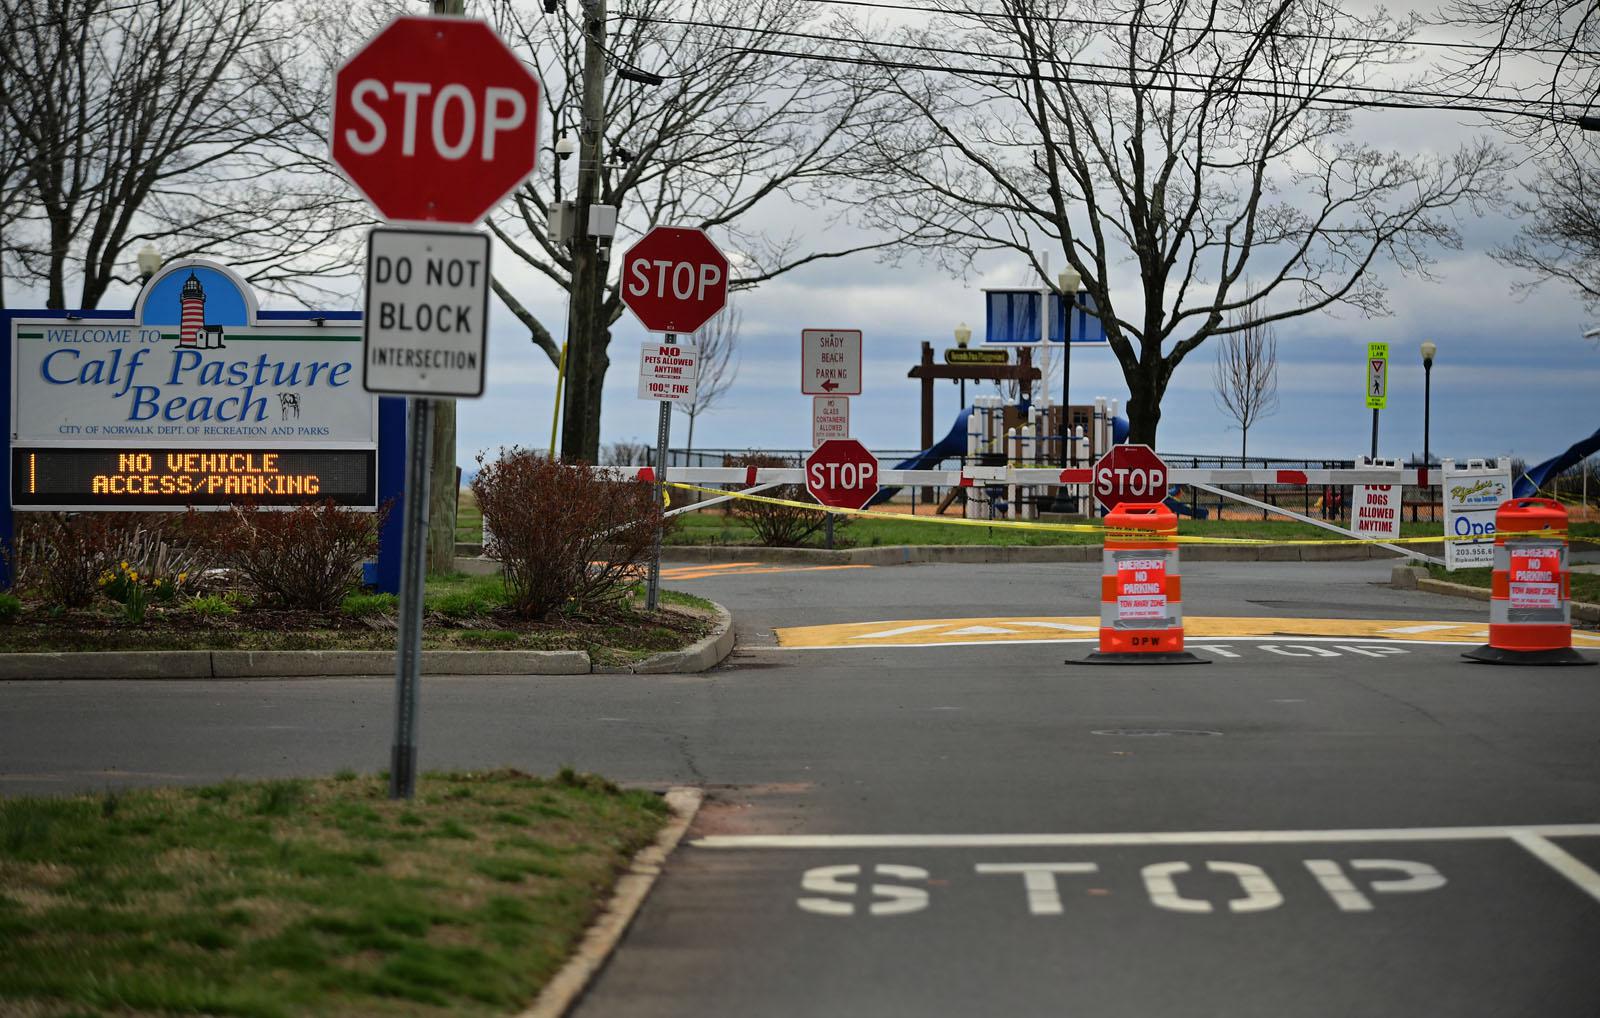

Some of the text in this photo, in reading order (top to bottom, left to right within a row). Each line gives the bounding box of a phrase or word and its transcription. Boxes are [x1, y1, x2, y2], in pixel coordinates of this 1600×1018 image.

[345, 78, 527, 161] STOP
[376, 255, 480, 288] DO NOT
[629, 257, 721, 301] STOP
[380, 302, 471, 333] BLOCK
[48, 330, 161, 343] WELCOME TO
[820, 337, 844, 348] SHADY
[659, 346, 681, 357] NO
[821, 352, 844, 363] BEACH
[372, 347, 477, 371] INTERSECTION
[644, 356, 694, 367] PETS ALLOWED
[42, 348, 352, 399] Calf Pasture
[654, 365, 682, 375] ANYTIME
[815, 368, 847, 379] PARKING
[672, 384, 689, 394] FINE
[128, 385, 269, 423] Beach
[59, 425, 330, 435] CITY OF NORWALK DEPT. OF RECREATION AND PARKS
[119, 453, 279, 472] NO VEHICLE
[810, 462, 874, 490] STOP
[1097, 468, 1164, 497] STOP
[92, 475, 320, 494] ACCESS/PARKING
[1366, 493, 1389, 505] DOGS
[1359, 506, 1394, 519] ALLOWED
[1359, 520, 1393, 533] ANYTIME
[1455, 516, 1495, 544] Ope
[1528, 558, 1540, 569] NO
[1135, 571, 1147, 582] NO
[1516, 570, 1552, 581] PARKING
[1124, 583, 1159, 594] PARKING
[1184, 644, 1411, 658] TOP
[797, 859, 1448, 915] STOP
